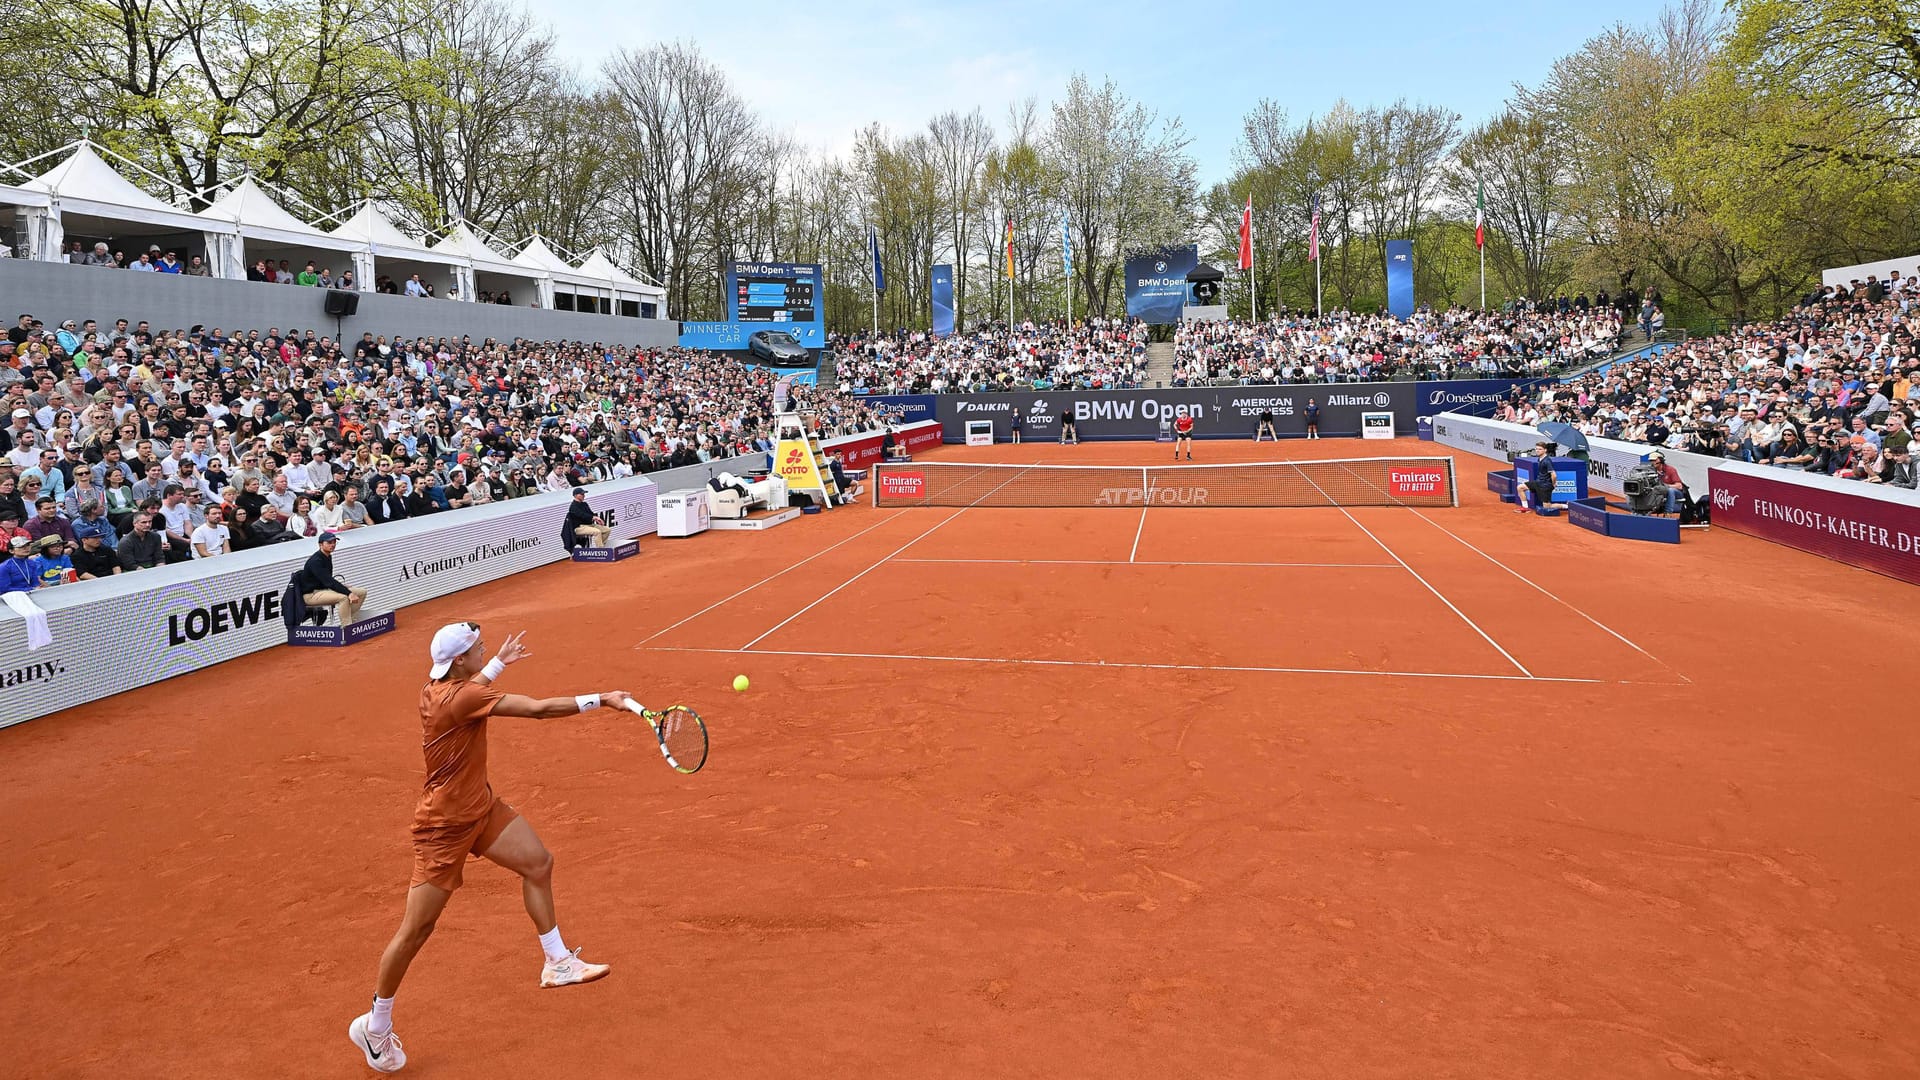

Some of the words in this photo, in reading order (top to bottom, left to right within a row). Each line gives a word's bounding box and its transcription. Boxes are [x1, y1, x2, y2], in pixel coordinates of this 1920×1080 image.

[736, 265, 759, 274] BMW
[761, 265, 784, 275] Open
[1138, 279, 1160, 287] BMW
[1162, 278, 1185, 287] Open
[683, 324, 740, 334] WINNER'S
[718, 334, 740, 343] CAR
[1231, 397, 1293, 407] AMERICAN
[1328, 394, 1371, 406] Allianz
[1446, 392, 1502, 403] OneStream
[884, 403, 926, 412] OneStream
[967, 402, 1010, 412] DAIKIN
[1074, 400, 1135, 420] BMW
[1141, 399, 1203, 423] Open
[1212, 404, 1222, 412] by
[1026, 415, 1053, 423] LOTTO
[1588, 459, 1611, 480] OEWE.
[883, 476, 922, 486] Emirates
[1391, 472, 1441, 483] Emirates
[1400, 483, 1411, 491] FLY
[1412, 482, 1434, 491] BETTER
[1094, 487, 1144, 505] ATP
[1148, 487, 1209, 505] TOUR
[1713, 488, 1740, 511] Käfer
[1754, 499, 1920, 555] FEINKOST-KAEFER.DE
[398, 564, 410, 582] A
[413, 554, 467, 578] Century
[468, 546, 481, 563] of
[482, 536, 541, 560] Excellence.
[351, 617, 389, 636] SMAVESTO
[295, 630, 335, 639] SMAVESTO
[0, 659, 65, 688] any.
